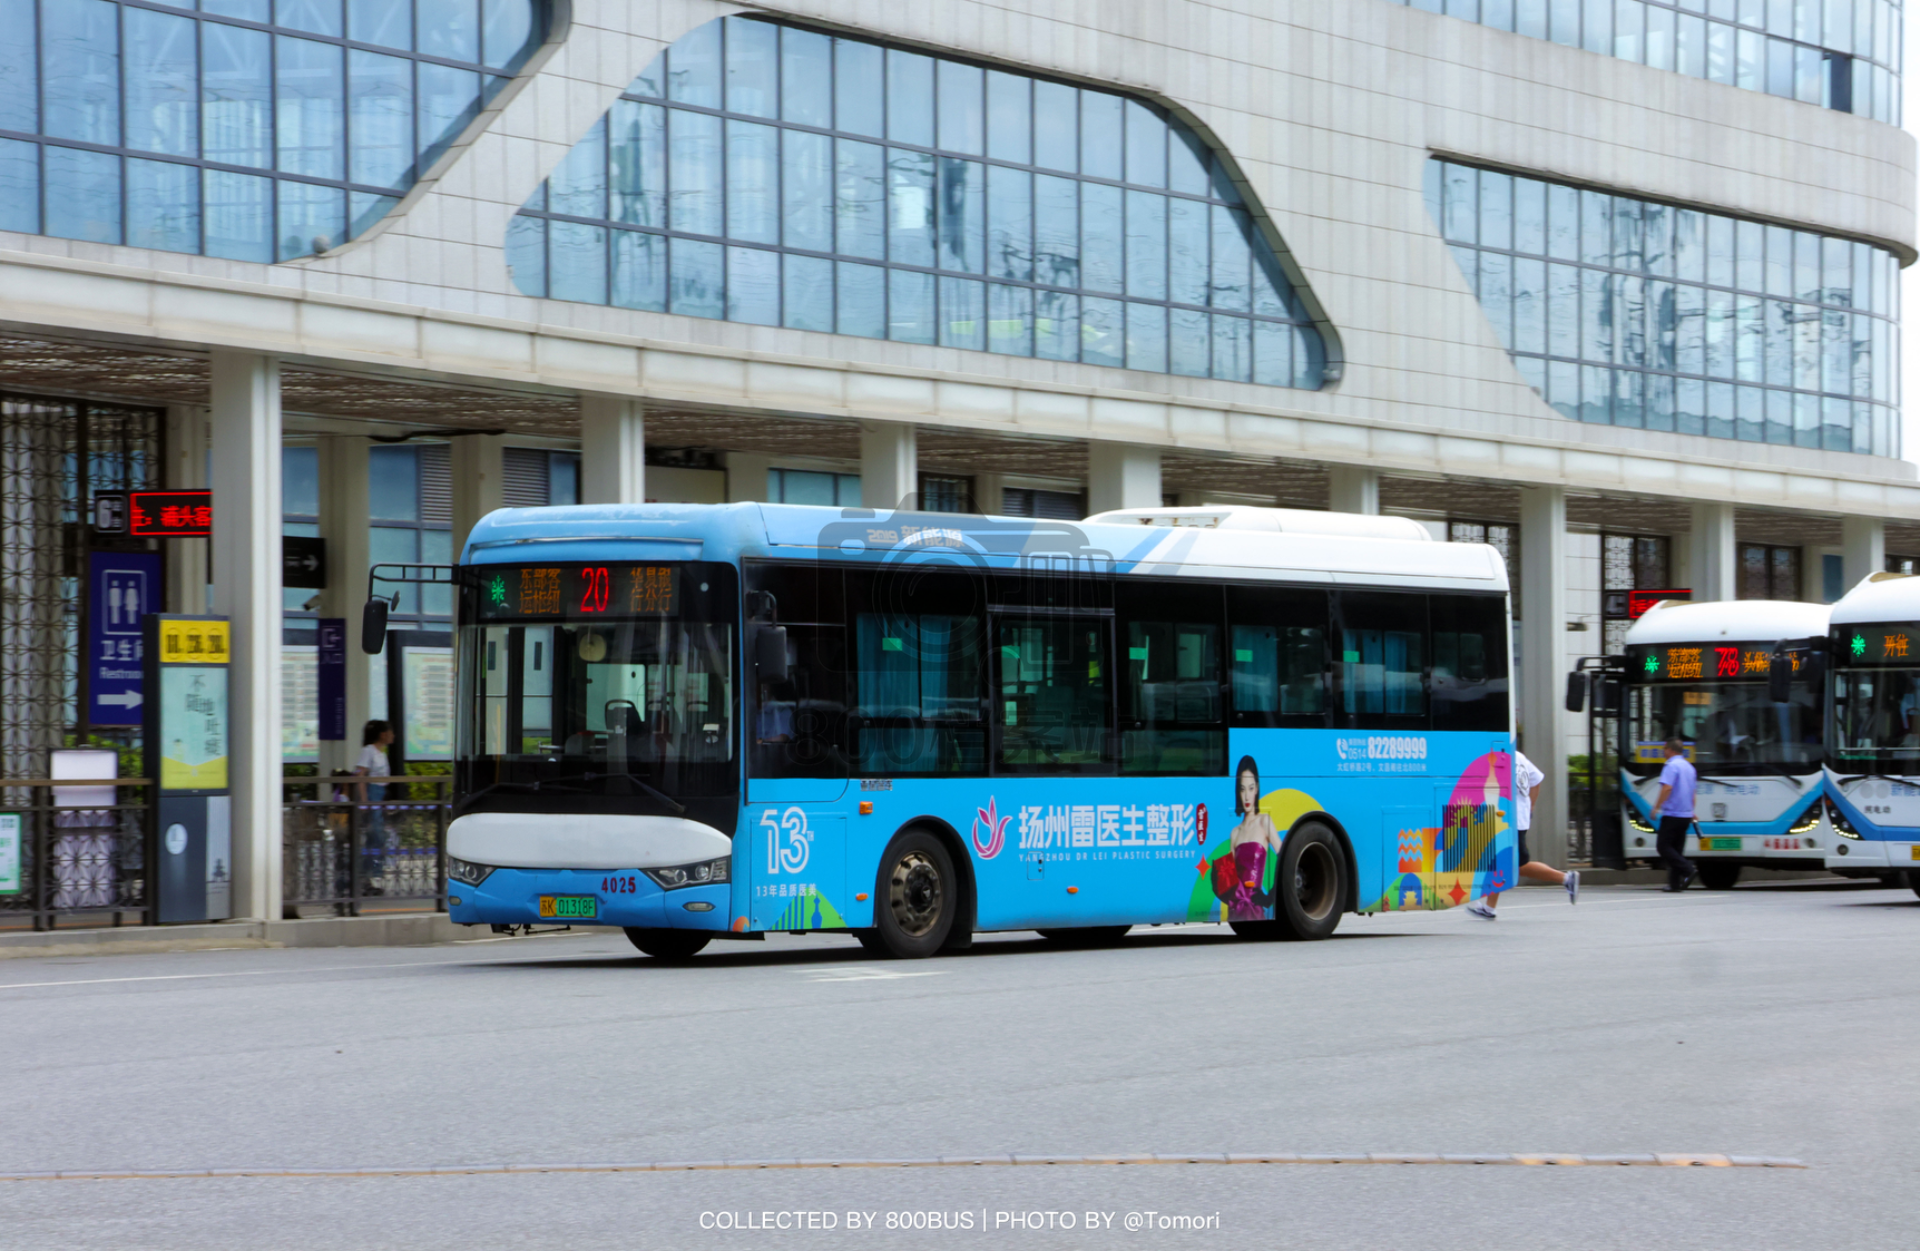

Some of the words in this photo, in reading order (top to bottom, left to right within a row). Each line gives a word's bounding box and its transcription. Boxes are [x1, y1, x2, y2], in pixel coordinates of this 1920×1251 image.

[580, 567, 609, 612] 20
[1348, 748, 1367, 760] 0514
[1367, 736, 1428, 760] 82289999
[1018, 803, 1195, 849] 扬州雷医生整形
[760, 806, 810, 874] 13
[1019, 853, 1071, 862] YANGZHOU
[1076, 852, 1088, 861] DR
[1093, 852, 1108, 861] LEI
[1112, 851, 1151, 860] PLASTIC
[1155, 850, 1196, 860] SURGERY
[601, 876, 636, 893] 4025
